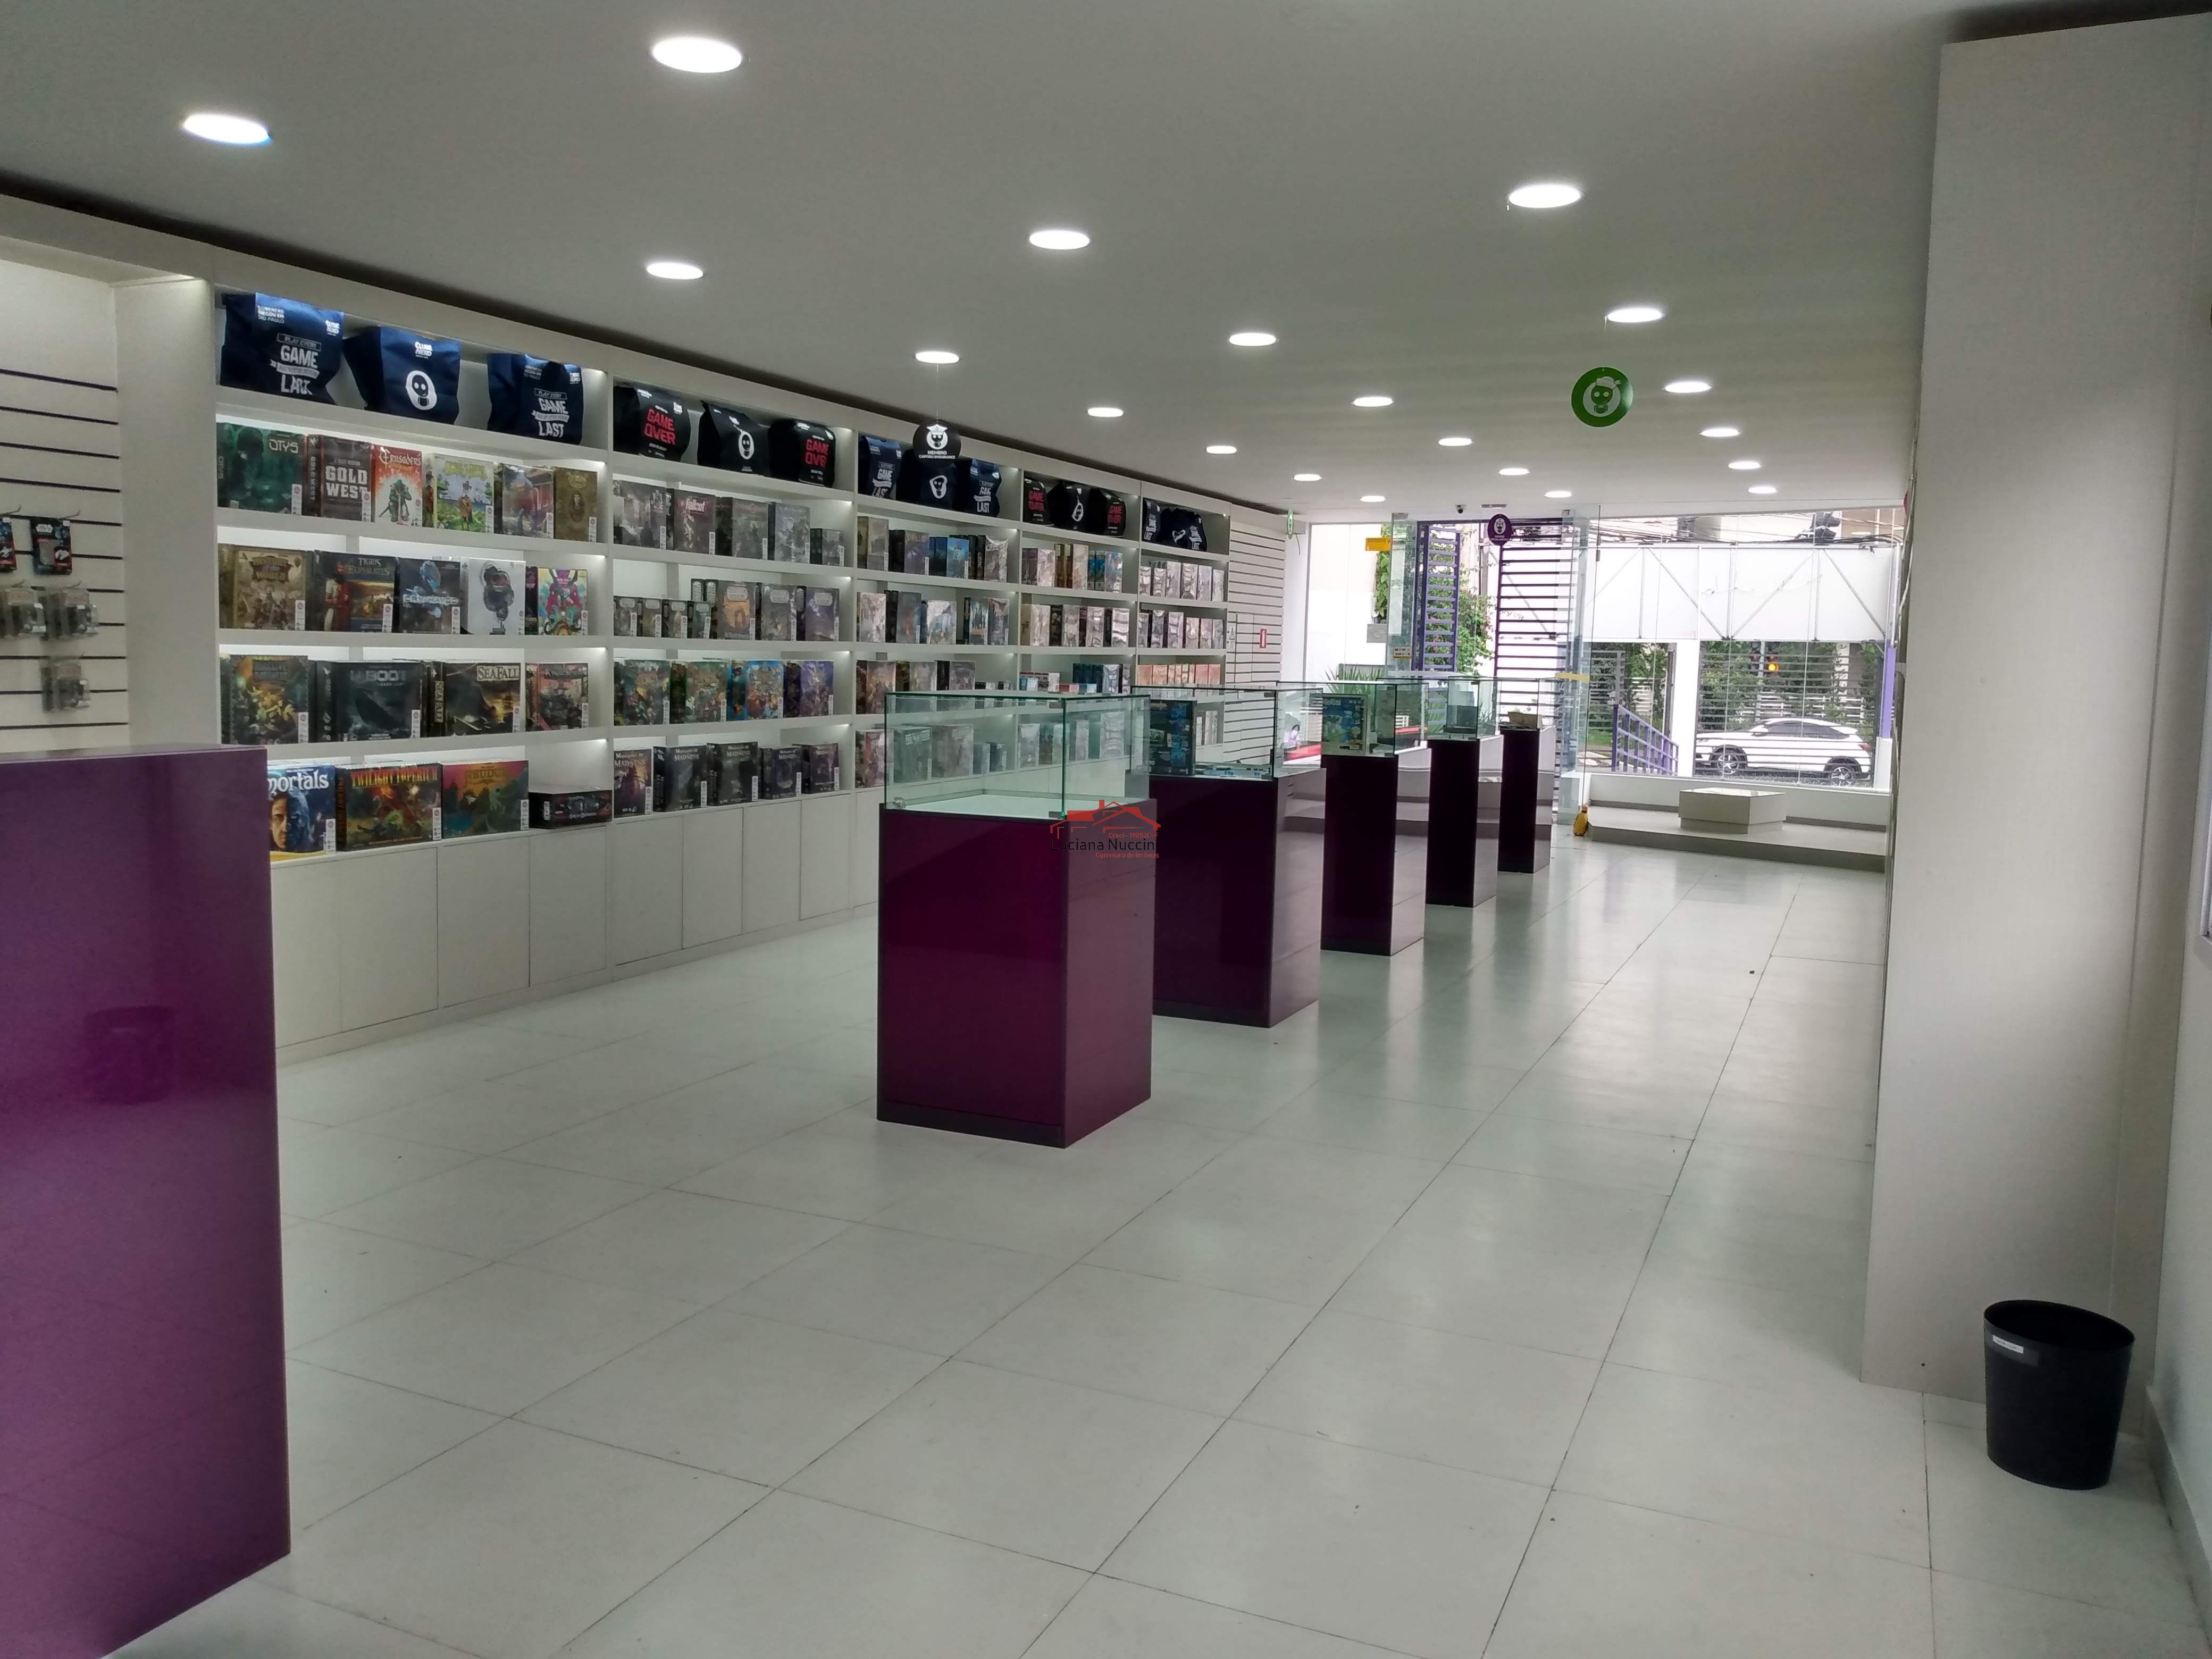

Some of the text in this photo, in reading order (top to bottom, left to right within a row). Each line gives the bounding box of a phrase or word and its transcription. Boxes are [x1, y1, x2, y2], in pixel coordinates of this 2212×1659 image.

[284, 336, 317, 349] PLAY EVERY
[280, 345, 319, 369] GAME
[538, 397, 569, 414] GAME
[647, 408, 675, 431] GAME
[538, 421, 565, 438] LAST
[644, 423, 676, 445] OVER
[269, 438, 299, 454] OTYS
[806, 439, 830, 456] GAME
[325, 465, 367, 485] GOLD
[877, 468, 893, 481] GAME
[1028, 490, 1044, 501] GAME
[685, 498, 706, 512] Fallout
[977, 501, 990, 514] LAST
[1028, 500, 1045, 511] OVER
[358, 557, 382, 567] TIGRIS
[477, 666, 520, 680] SEAFALL
